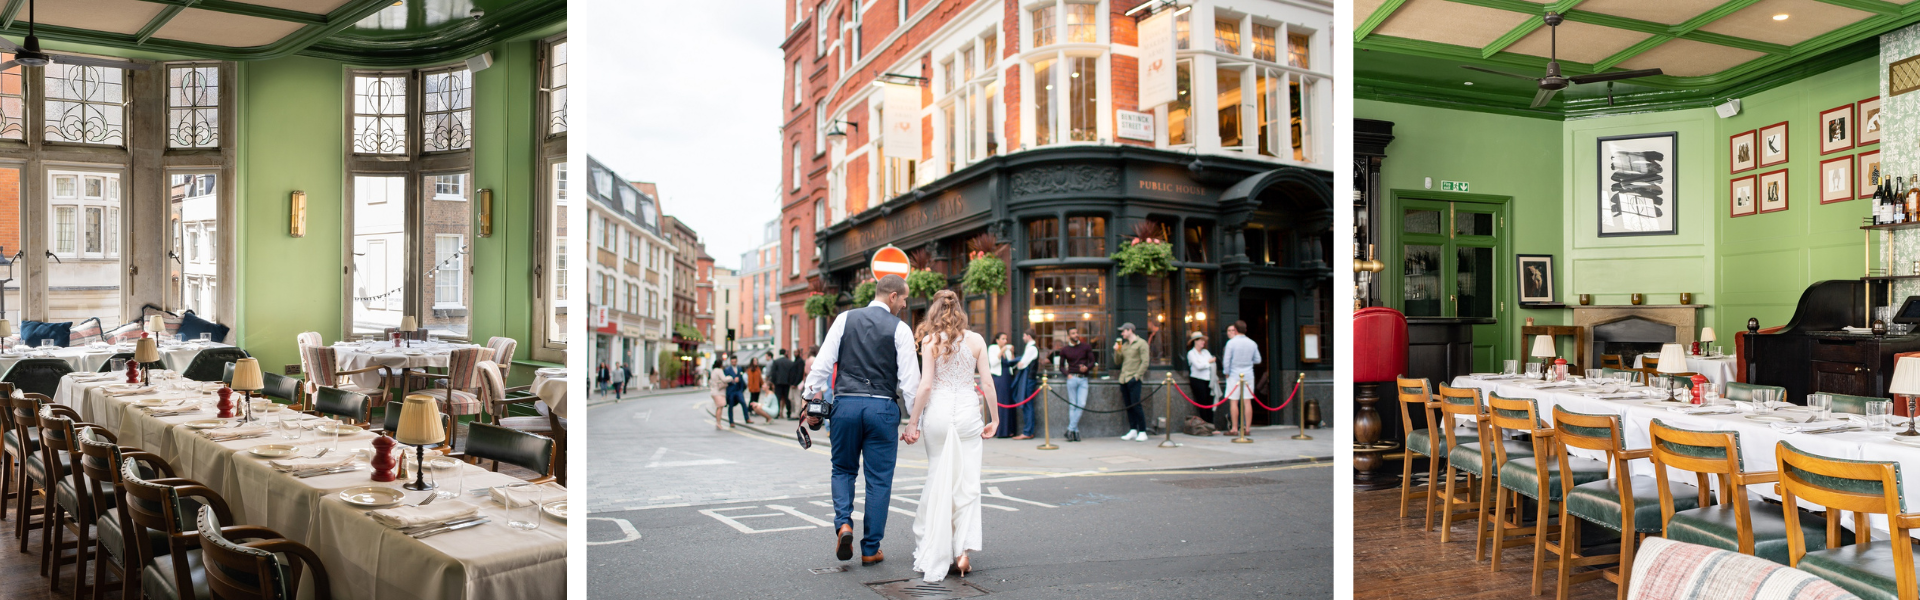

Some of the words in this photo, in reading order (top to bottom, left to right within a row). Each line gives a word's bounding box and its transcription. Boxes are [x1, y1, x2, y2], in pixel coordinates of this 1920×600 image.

[1121, 113, 1149, 123] BENTINCK
[1121, 121, 1142, 130] STREET
[1139, 180, 1173, 192] PUBLIC
[1175, 184, 1206, 196] HOUSE
[843, 235, 858, 254] THE
[860, 222, 888, 247] COACH
[889, 208, 929, 236] MAKERS
[932, 194, 964, 221] ARMS
